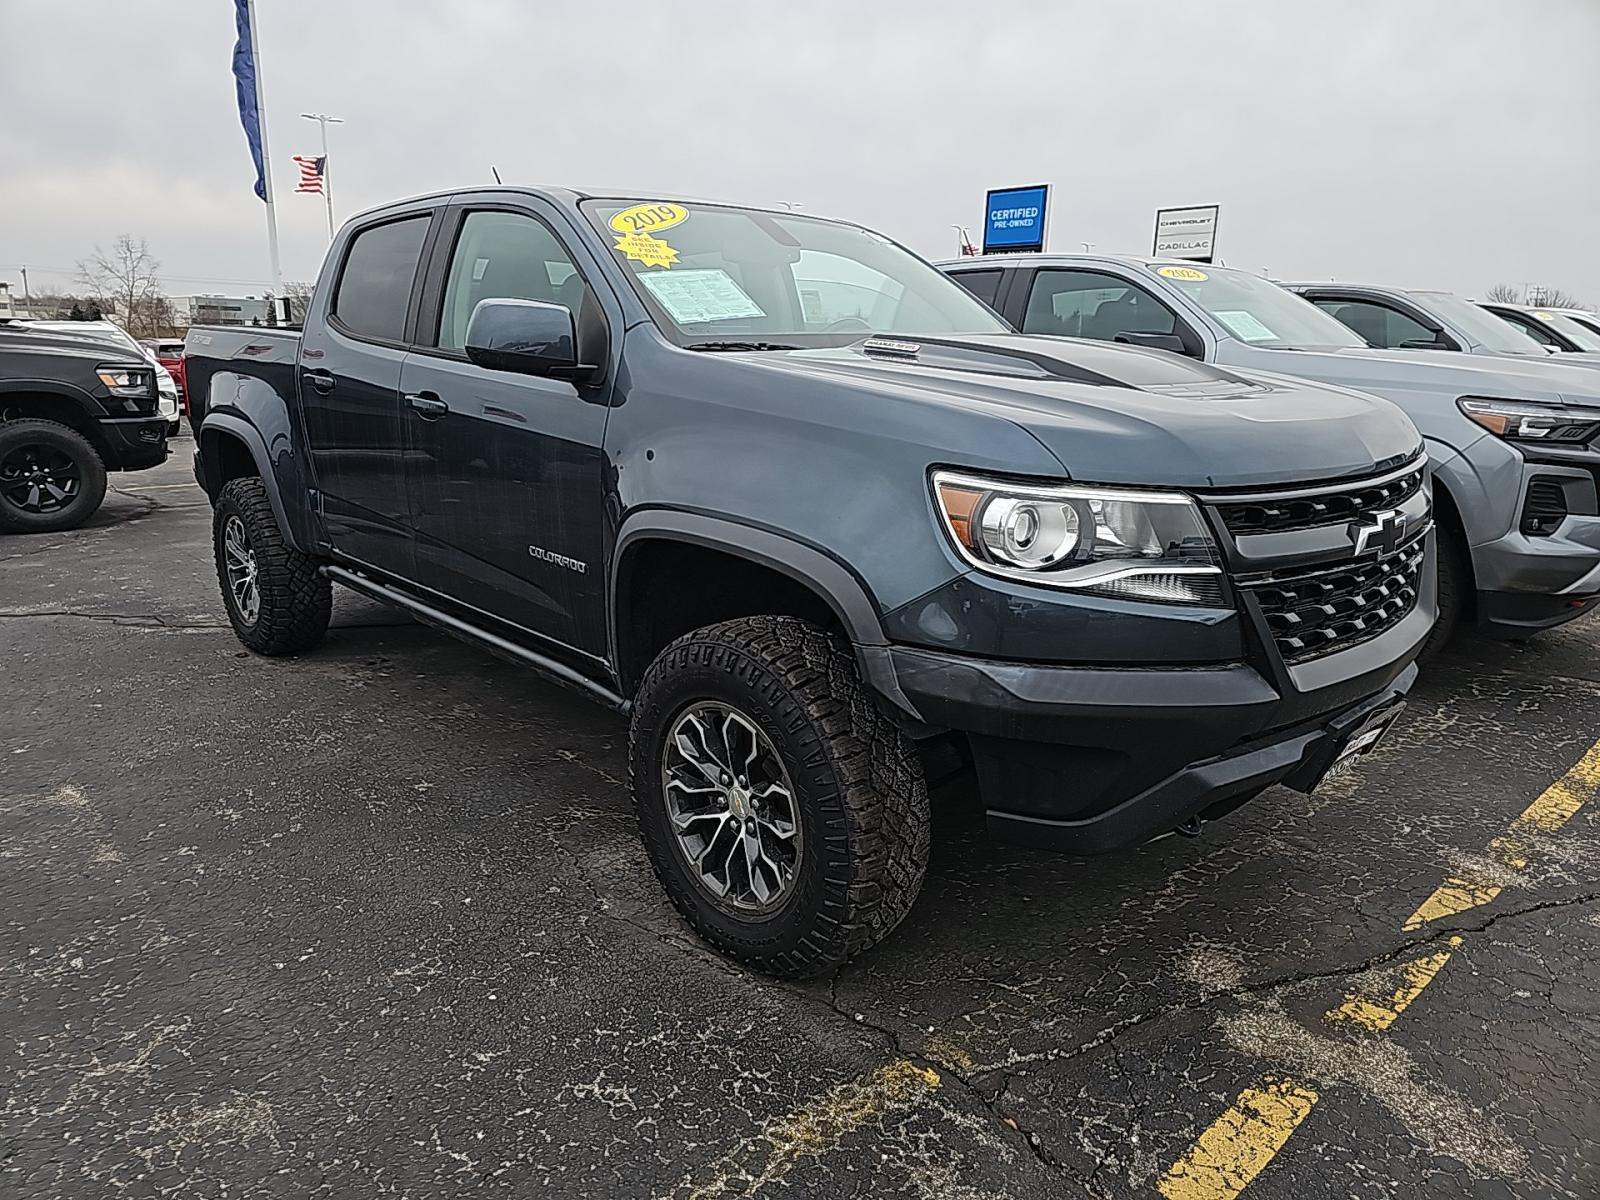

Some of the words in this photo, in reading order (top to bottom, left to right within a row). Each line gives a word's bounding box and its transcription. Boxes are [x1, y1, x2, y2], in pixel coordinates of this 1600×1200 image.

[623, 206, 676, 230] 2019
[991, 207, 1038, 220] CERTIFIED
[994, 219, 1034, 229] PRE-OWNED
[1160, 218, 1211, 226] CHEVROLET
[1158, 241, 1209, 251] CADILLAC
[528, 545, 586, 574] COLORADO
